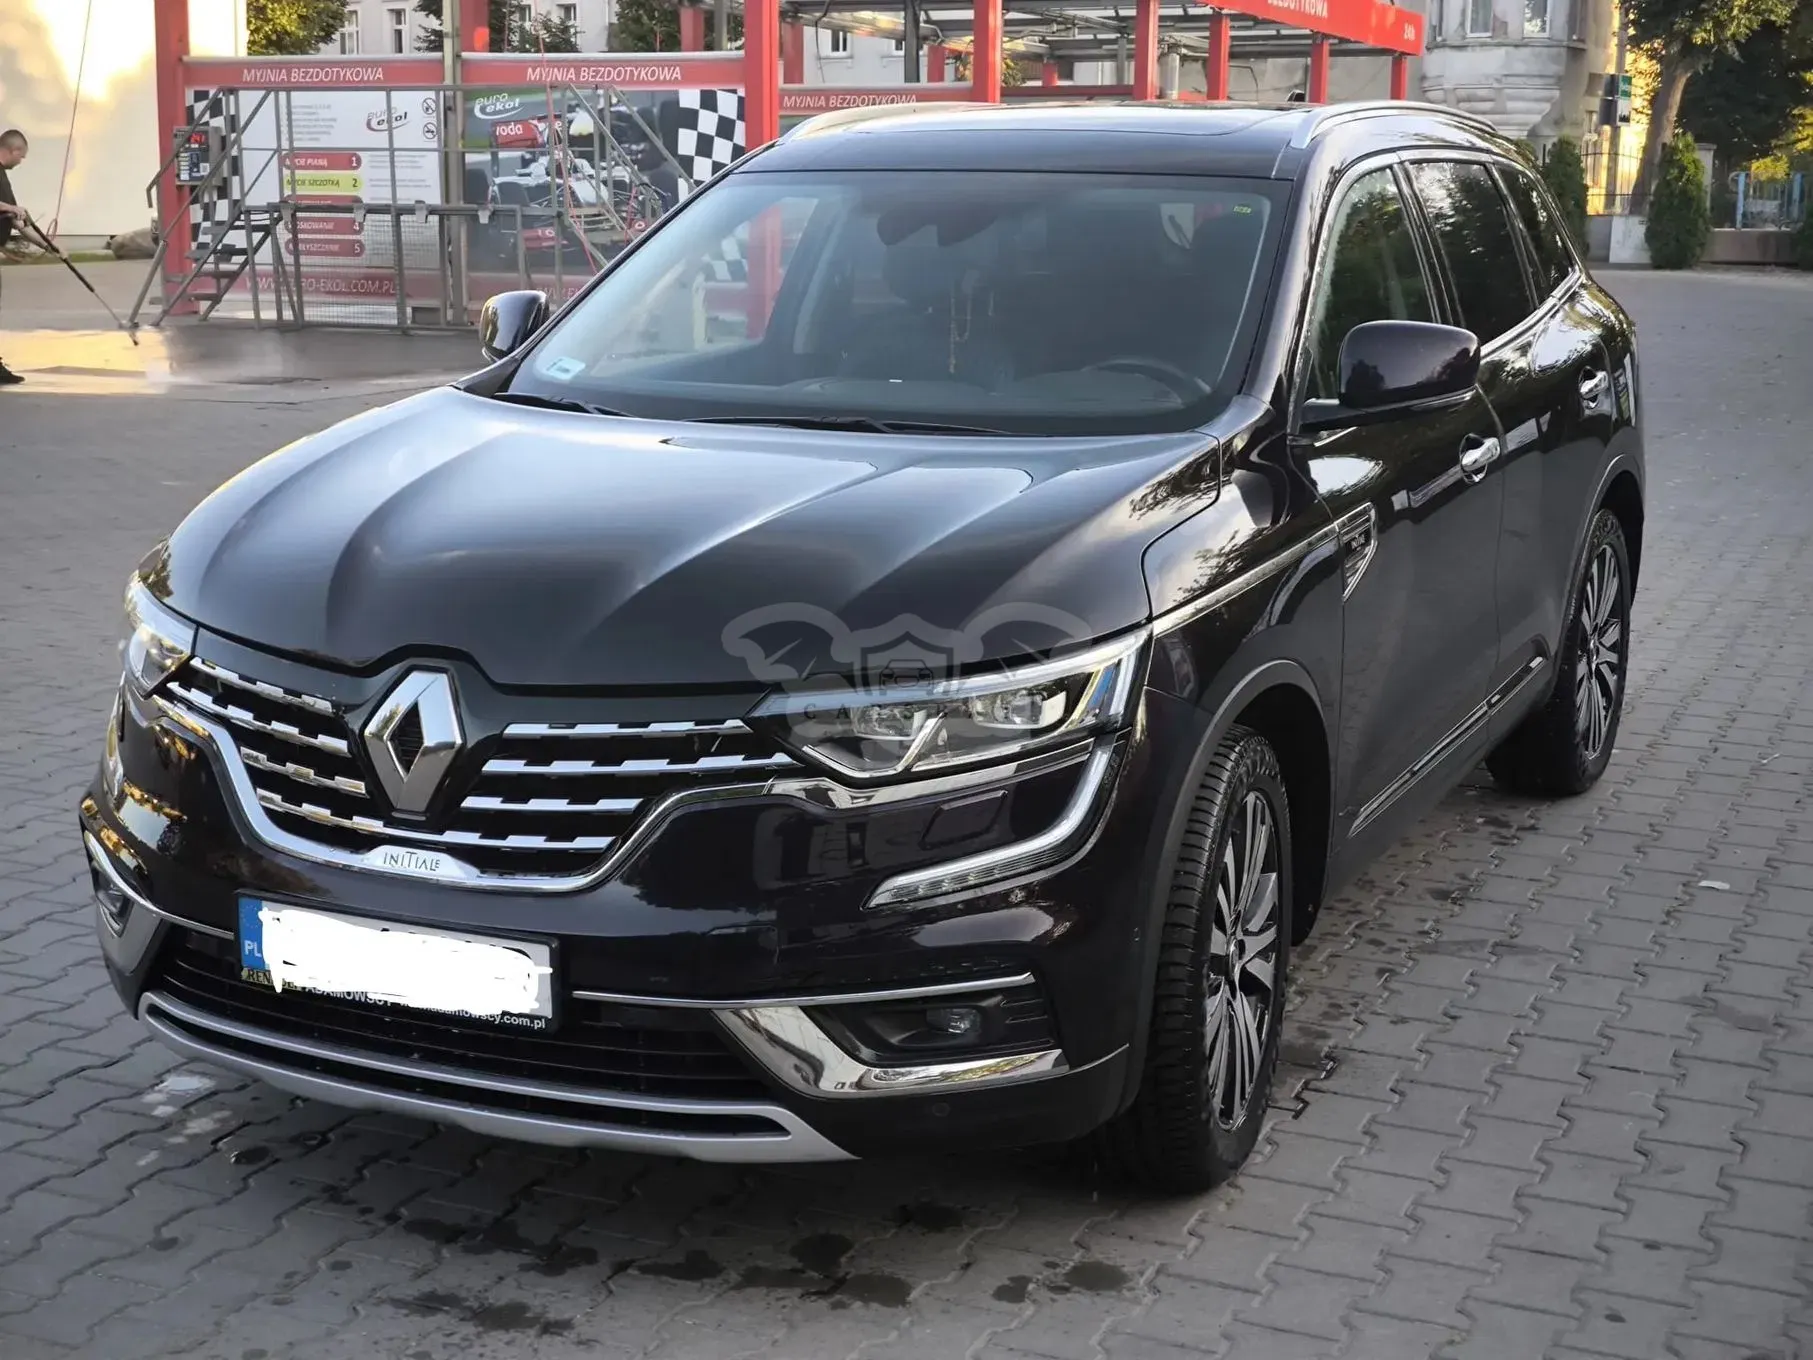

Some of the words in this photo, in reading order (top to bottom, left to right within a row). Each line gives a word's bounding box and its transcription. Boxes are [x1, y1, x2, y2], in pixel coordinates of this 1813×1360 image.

[242, 69, 288, 83] MYJNIA
[291, 67, 384, 82] BEZDOTYKOWA
[527, 67, 576, 82] MYJNIA
[580, 66, 682, 82] BEZDOTYKOWA
[475, 92, 509, 106] euro
[485, 98, 520, 112] ekol
[783, 95, 826, 108] MYJNIA
[351, 156, 357, 166] 1
[352, 178, 358, 187] 2
[354, 243, 360, 253] 5
[383, 850, 441, 872] INITIALE
[243, 939, 263, 958] PL
